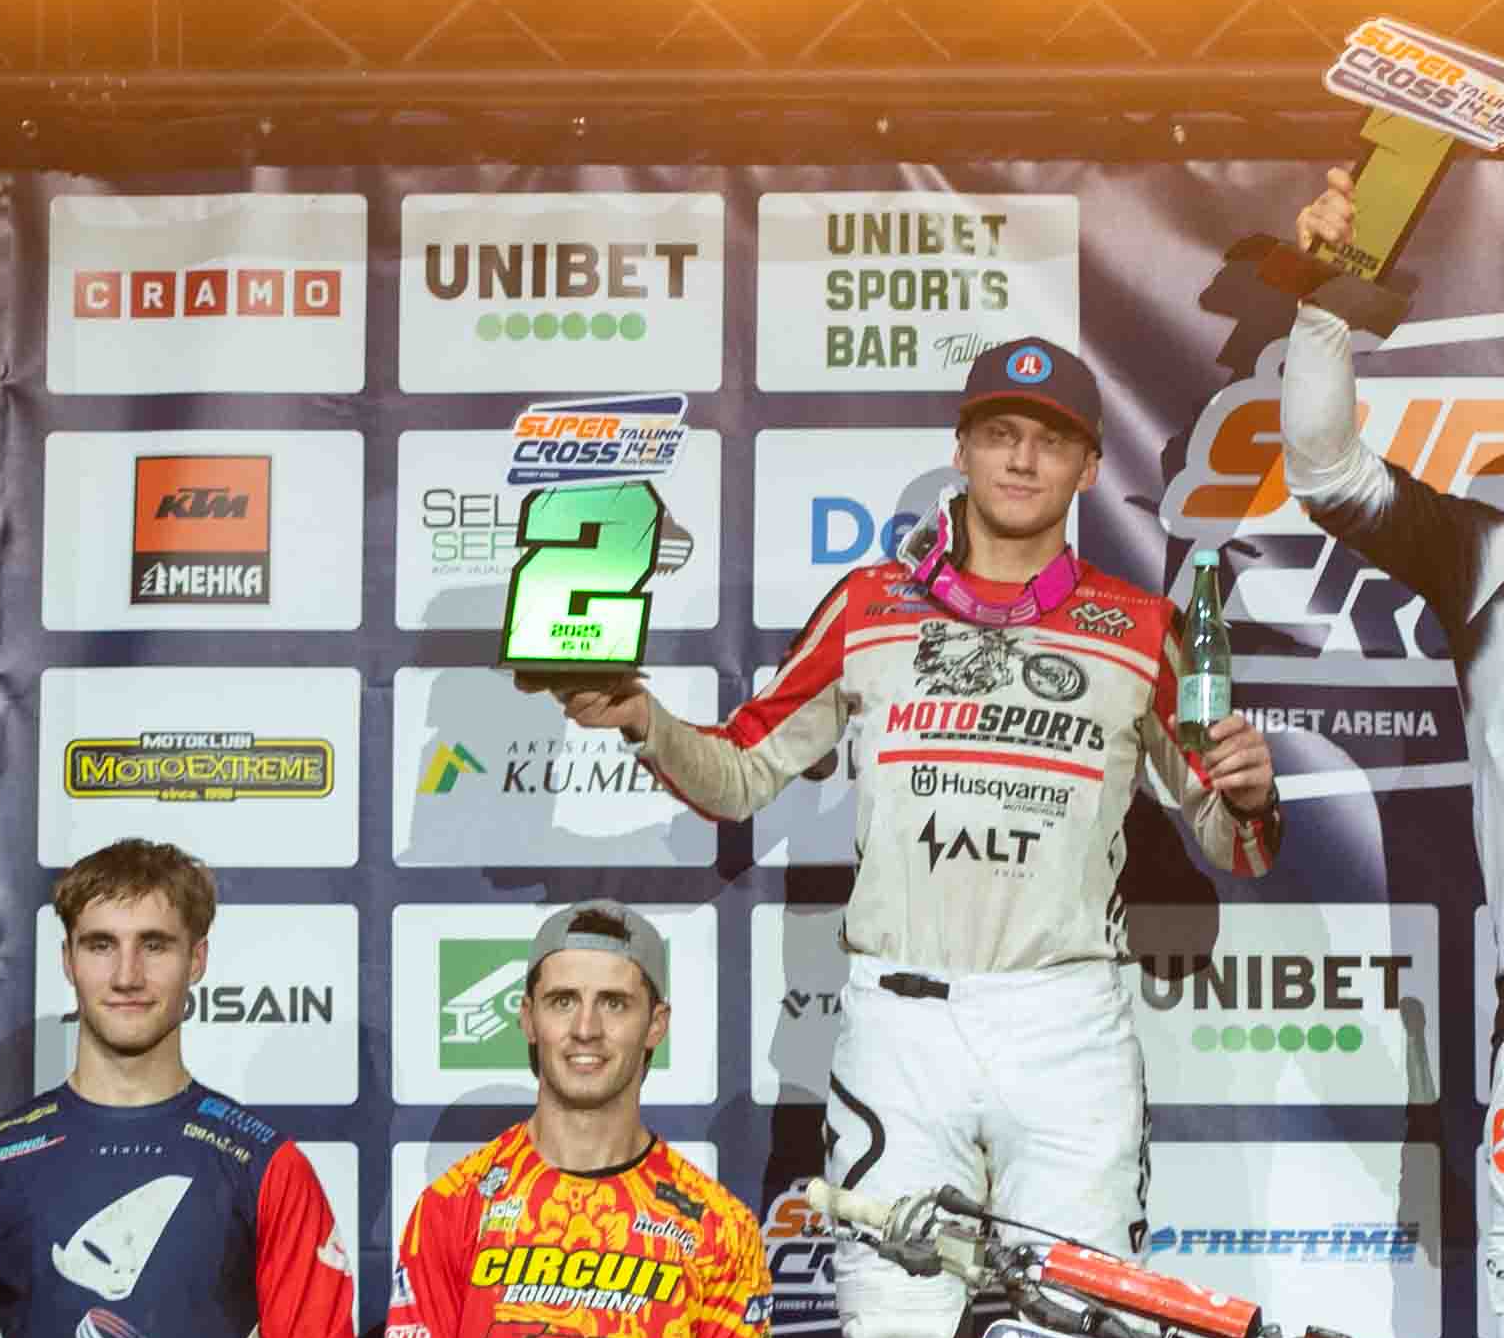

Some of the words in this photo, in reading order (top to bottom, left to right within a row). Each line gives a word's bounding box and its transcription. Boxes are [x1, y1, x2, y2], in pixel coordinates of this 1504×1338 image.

[1353, 24, 1470, 87] SUPER
[1342, 46, 1458, 111] CROSS
[826, 213, 1008, 256] UNIBET
[424, 242, 698, 301] UNIBET
[825, 269, 1009, 311] SPORTS
[80, 274, 333, 314] CRAMO
[825, 325, 918, 367] BAR
[515, 414, 623, 440] SUPER
[618, 427, 684, 441] TALLINN
[512, 439, 623, 465] CROSS
[622, 441, 680, 460] 14-15
[153, 487, 250, 521] KTM
[422, 487, 519, 529] SEL
[166, 563, 265, 598] MEHKA
[141, 734, 253, 750] MOTOKLUBI
[885, 701, 1106, 752] MOTOSPORTS
[1332, 709, 1439, 737] ARENA
[941, 771, 1070, 805] Husqvarna
[1141, 953, 1413, 1012] UNIBET
[1179, 1225, 1419, 1258] FREETIME
[471, 1245, 684, 1303] CIRCUIT
